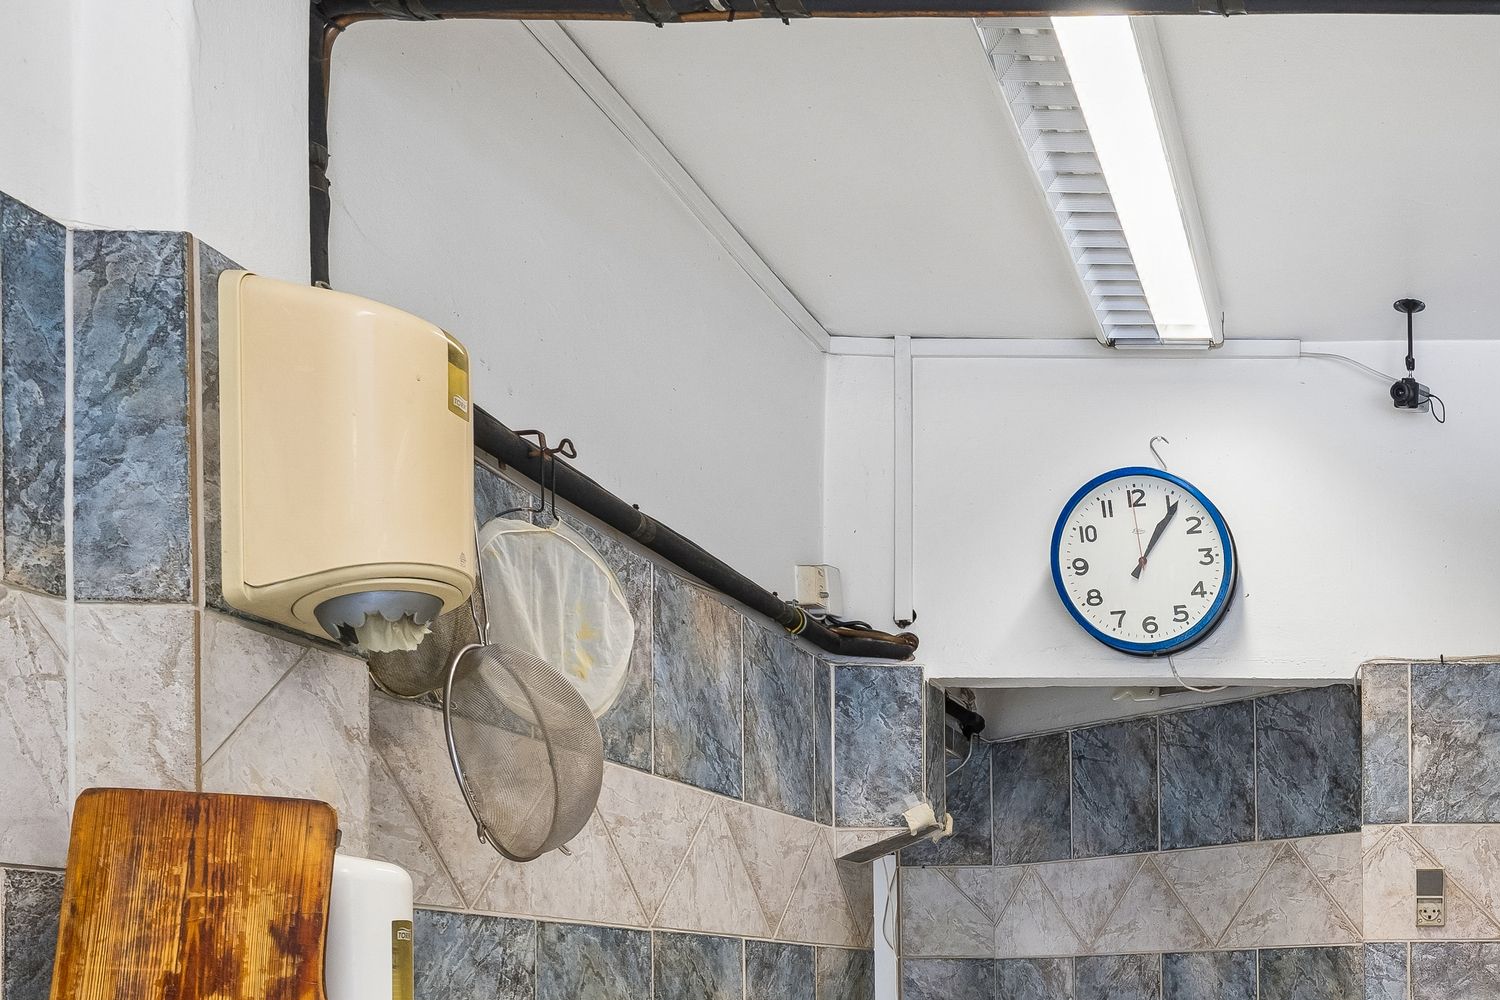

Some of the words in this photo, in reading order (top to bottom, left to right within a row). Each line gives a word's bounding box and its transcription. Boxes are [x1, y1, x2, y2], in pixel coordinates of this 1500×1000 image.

[1127, 489, 1146, 508] 12
[1101, 500, 1113, 518] 11
[1079, 525, 1097, 543] 10
[1185, 516, 1202, 534] 2
[1198, 547, 1214, 565] 3
[1072, 558, 1089, 576] 9
[1086, 589, 1103, 606] 8
[1191, 581, 1207, 598] 4
[1110, 610, 1126, 628] 7
[1173, 605, 1189, 622] 5
[1142, 616, 1158, 634] 6
